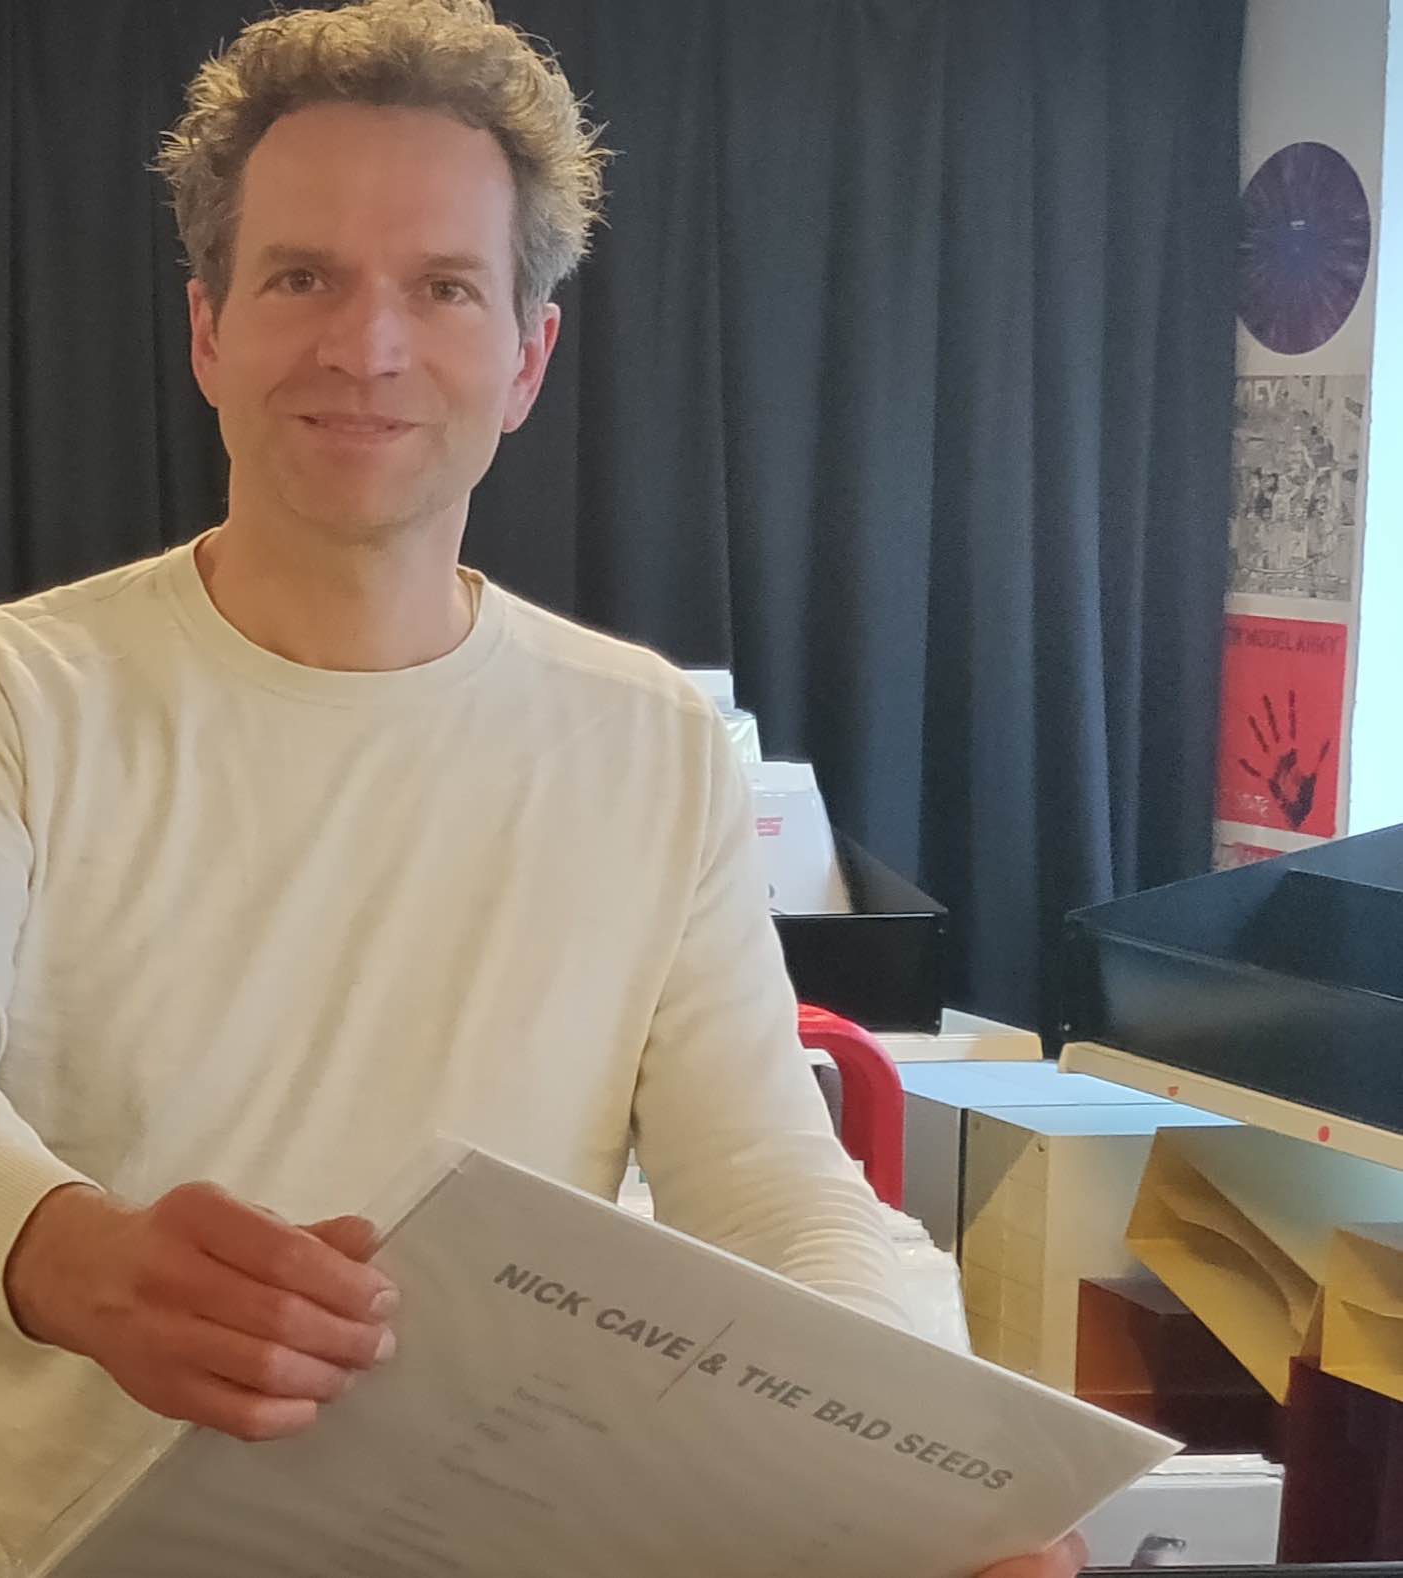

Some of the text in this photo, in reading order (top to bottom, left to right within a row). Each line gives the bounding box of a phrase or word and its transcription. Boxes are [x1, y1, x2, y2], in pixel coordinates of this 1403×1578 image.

[493, 1262, 1014, 1491] NICK CAVE & THE BAD SEEDS
